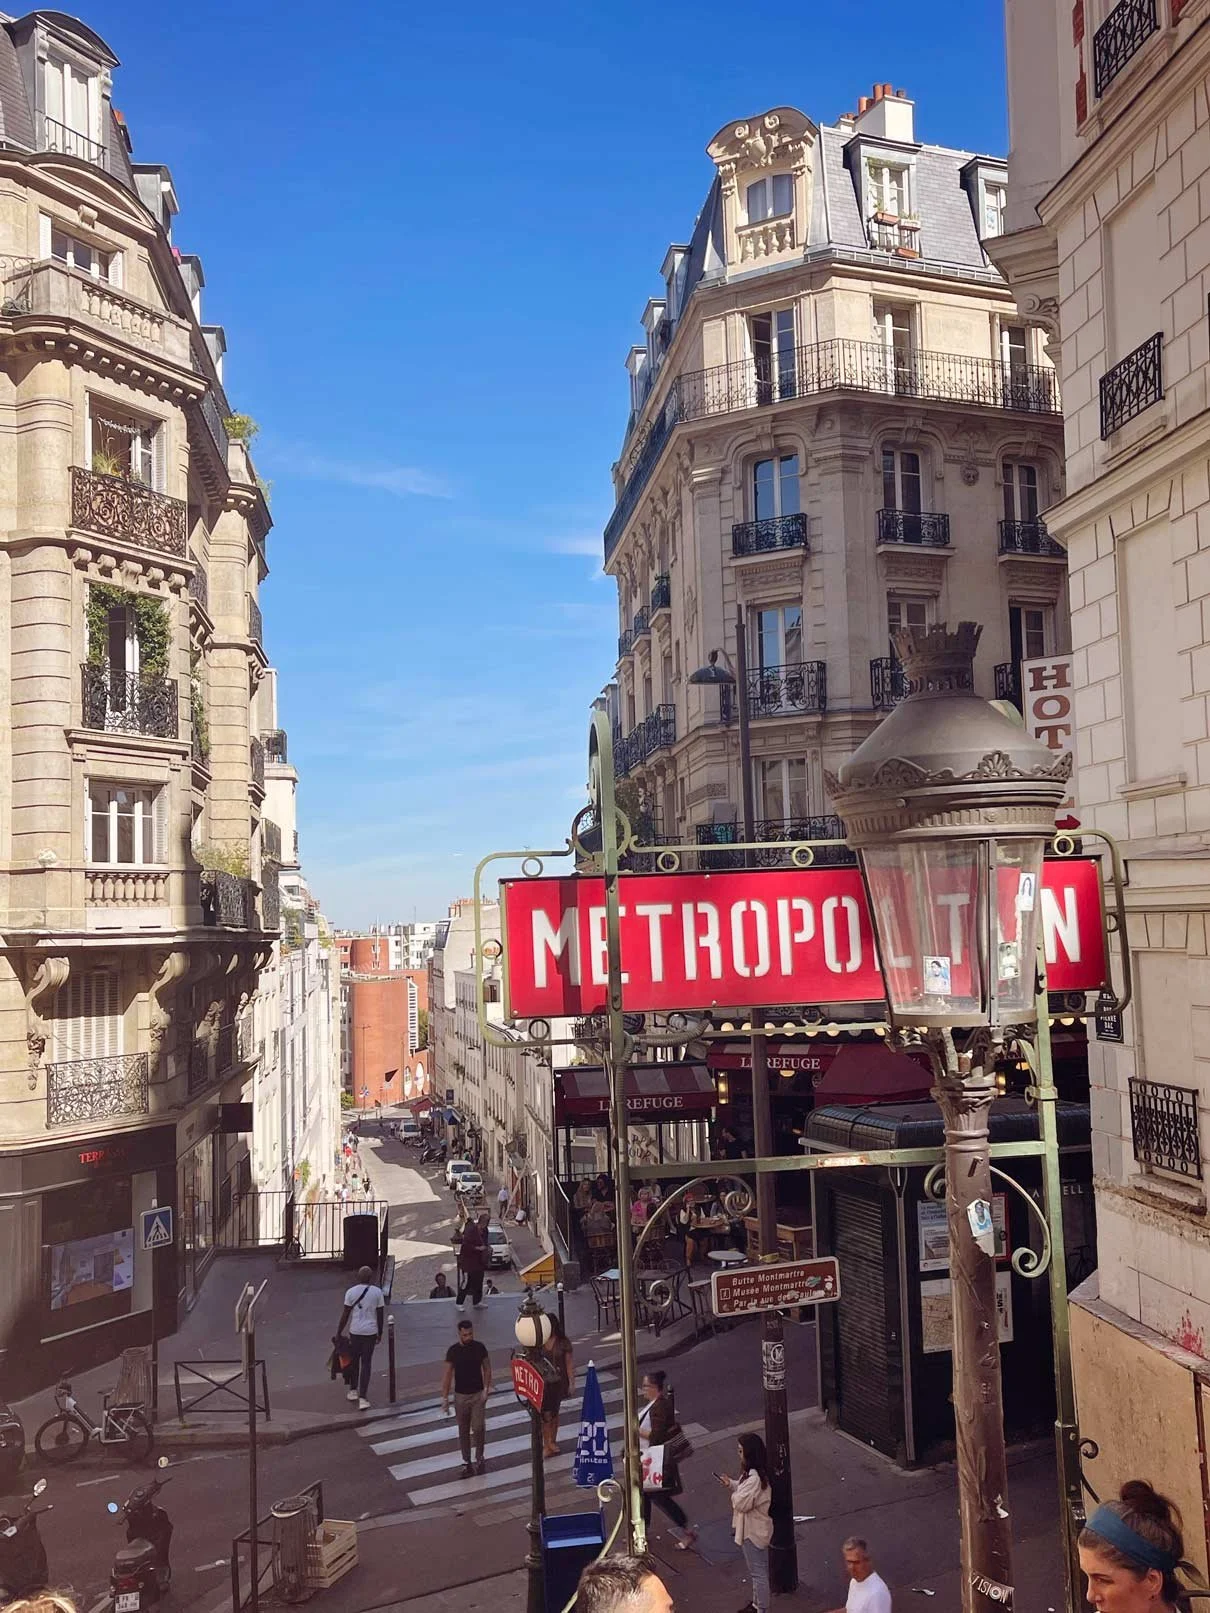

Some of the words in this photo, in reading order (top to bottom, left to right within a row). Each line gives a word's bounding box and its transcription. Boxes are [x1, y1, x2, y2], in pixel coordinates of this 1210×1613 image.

[1029, 664, 1074, 809] HOT
[732, 1276, 755, 1286] Butte
[758, 1270, 805, 1283] Montmartre
[733, 1286, 759, 1297] Musée
[733, 1299, 747, 1308] Par
[514, 1366, 539, 1394] METRO
[577, 1422, 608, 1456] 20
